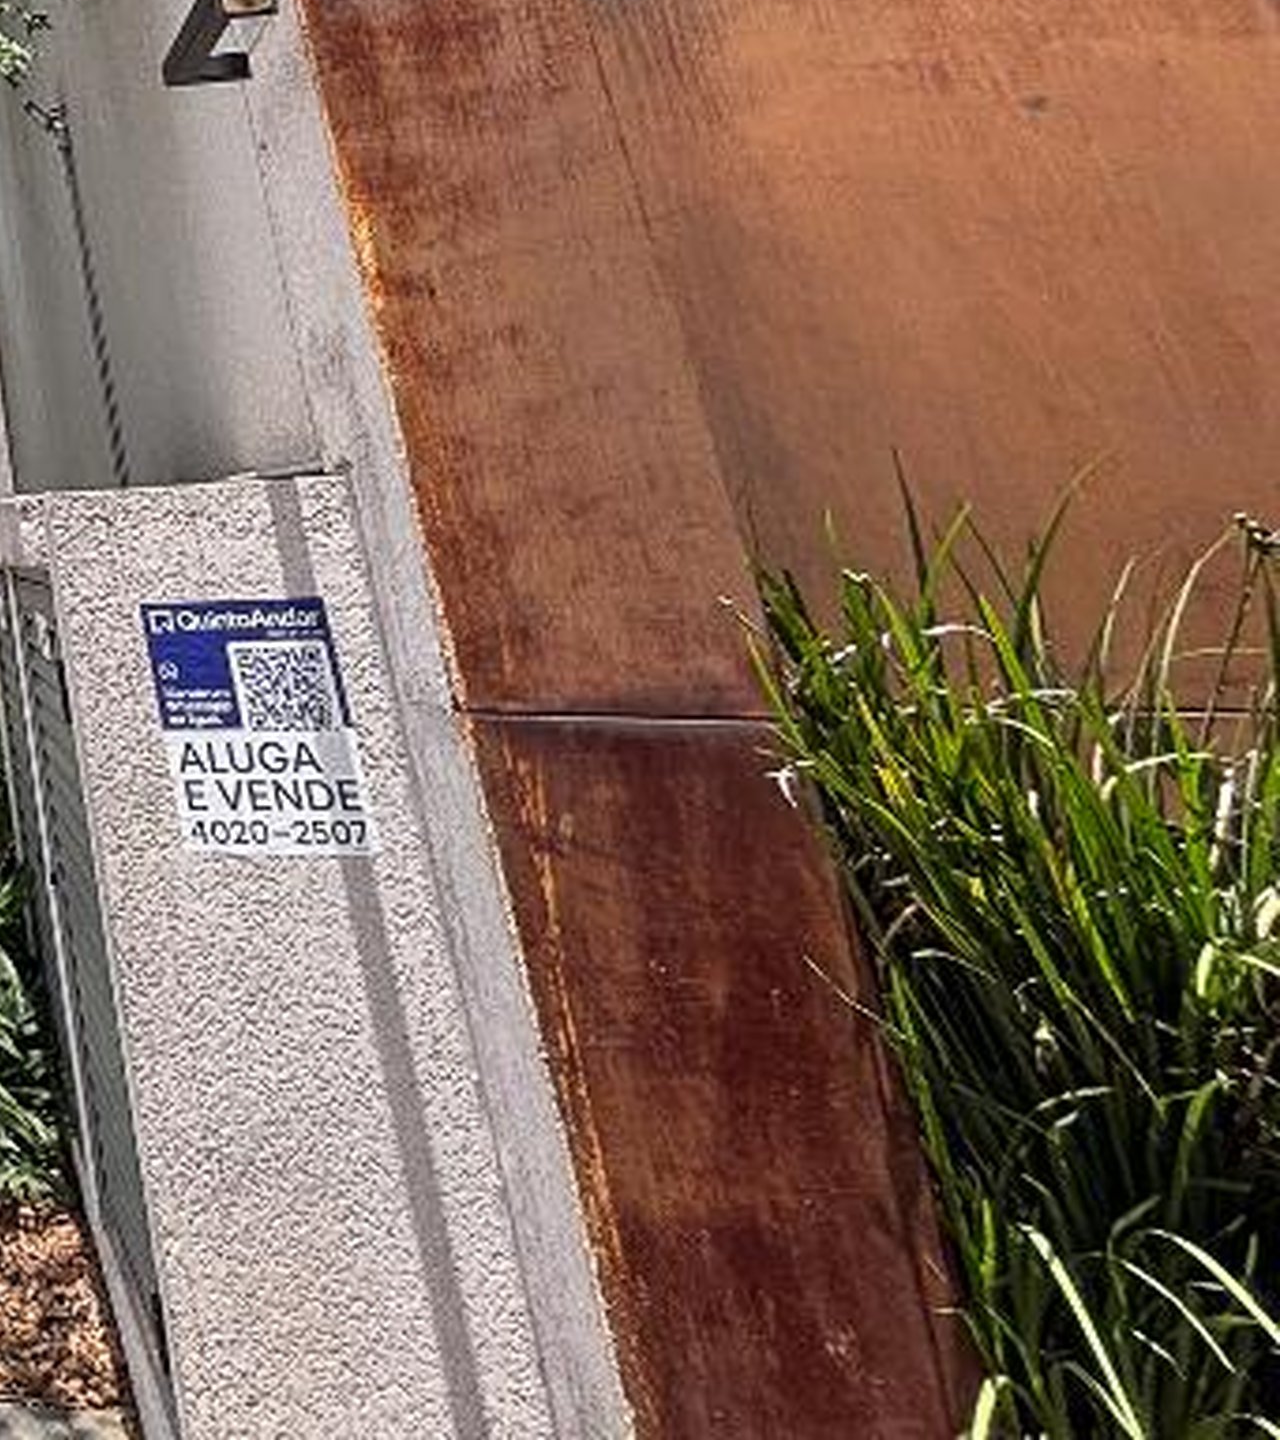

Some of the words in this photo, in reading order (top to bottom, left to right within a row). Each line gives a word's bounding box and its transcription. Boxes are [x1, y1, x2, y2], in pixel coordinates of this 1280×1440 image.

[180, 741, 323, 773] ALUGA
[184, 780, 208, 810] E
[215, 779, 363, 811] VENDE
[191, 820, 367, 845] 4020-2507
